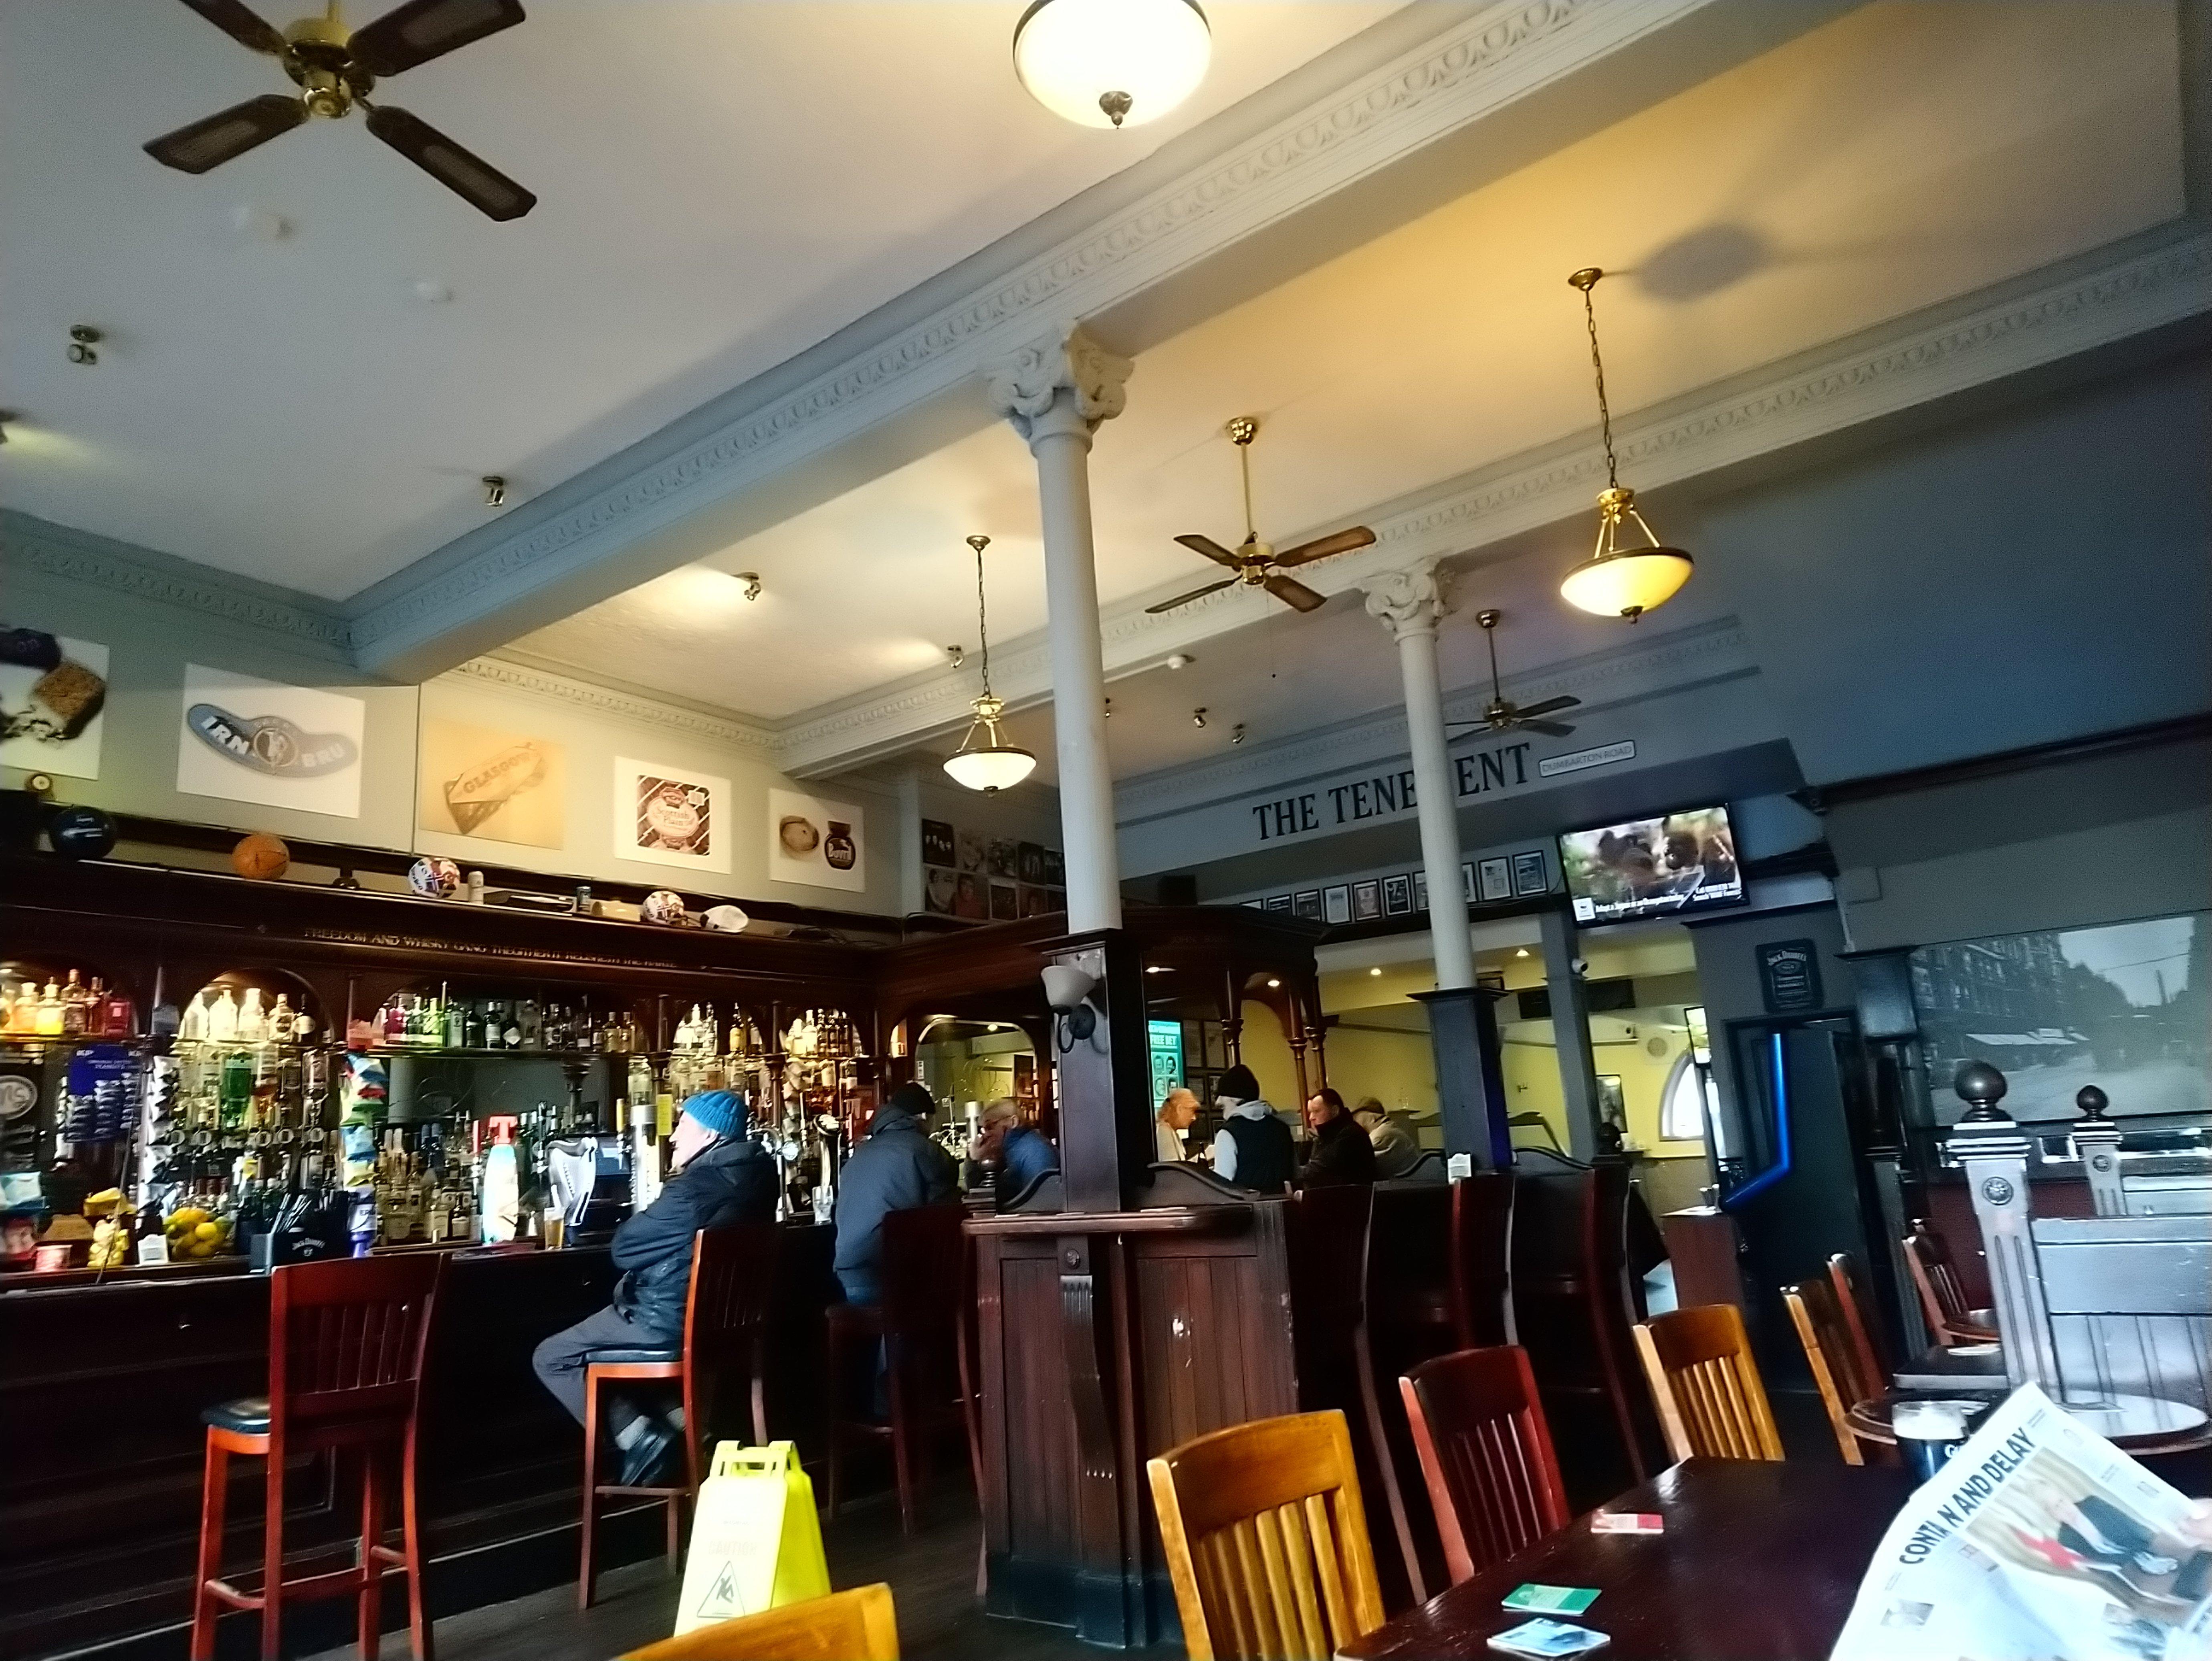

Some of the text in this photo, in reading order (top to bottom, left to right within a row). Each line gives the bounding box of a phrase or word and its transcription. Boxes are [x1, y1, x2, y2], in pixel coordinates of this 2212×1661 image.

[201, 715, 346, 767] IRN BRU
[1605, 746, 1632, 759] ROAD
[462, 750, 532, 794] GLASGOW
[1252, 742, 1530, 840] THE TENEENT
[828, 843, 852, 861] Bovril
[371, 934, 400, 946] AND
[1952, 1474, 1994, 1516] AND
[1980, 1426, 2036, 1483] DELAY
[708, 1540, 757, 1556] CAUTION
